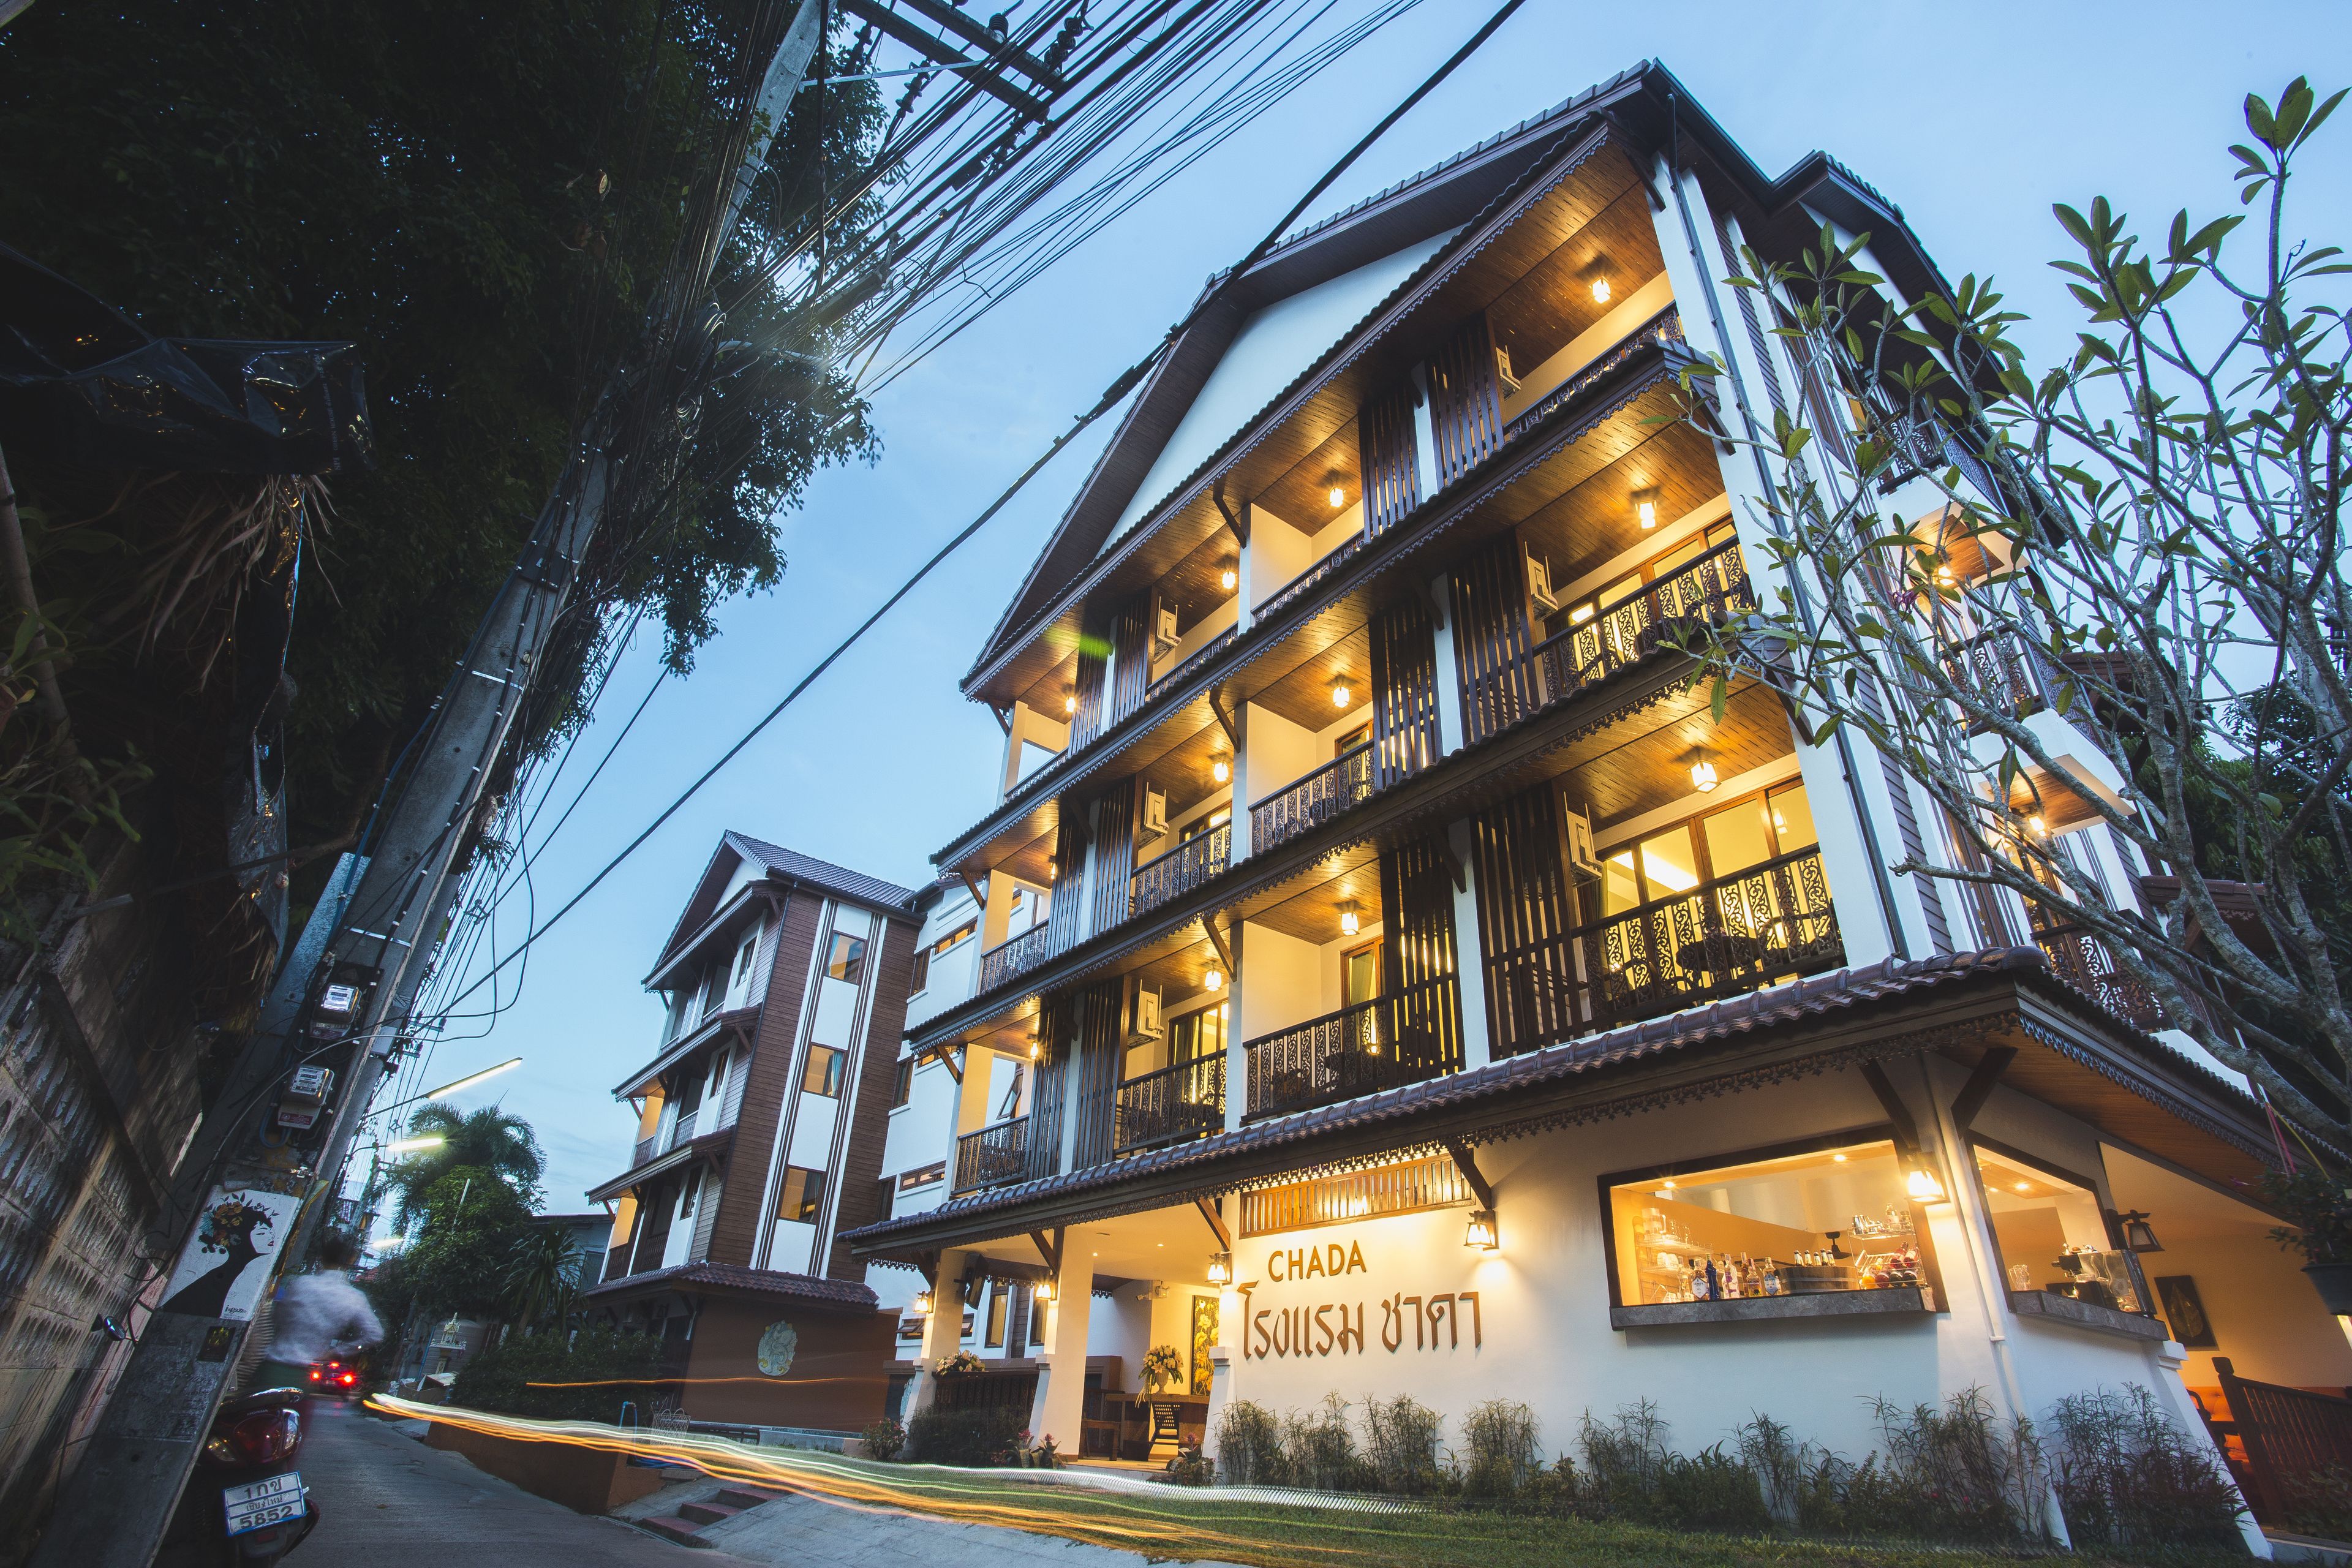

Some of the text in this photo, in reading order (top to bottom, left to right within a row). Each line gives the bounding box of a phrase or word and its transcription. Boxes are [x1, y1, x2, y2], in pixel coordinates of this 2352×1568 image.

[1267, 1240, 1367, 1283] CHADA
[1237, 1280, 1363, 1360] โรงแรม
[239, 1506, 293, 1529] 5852
